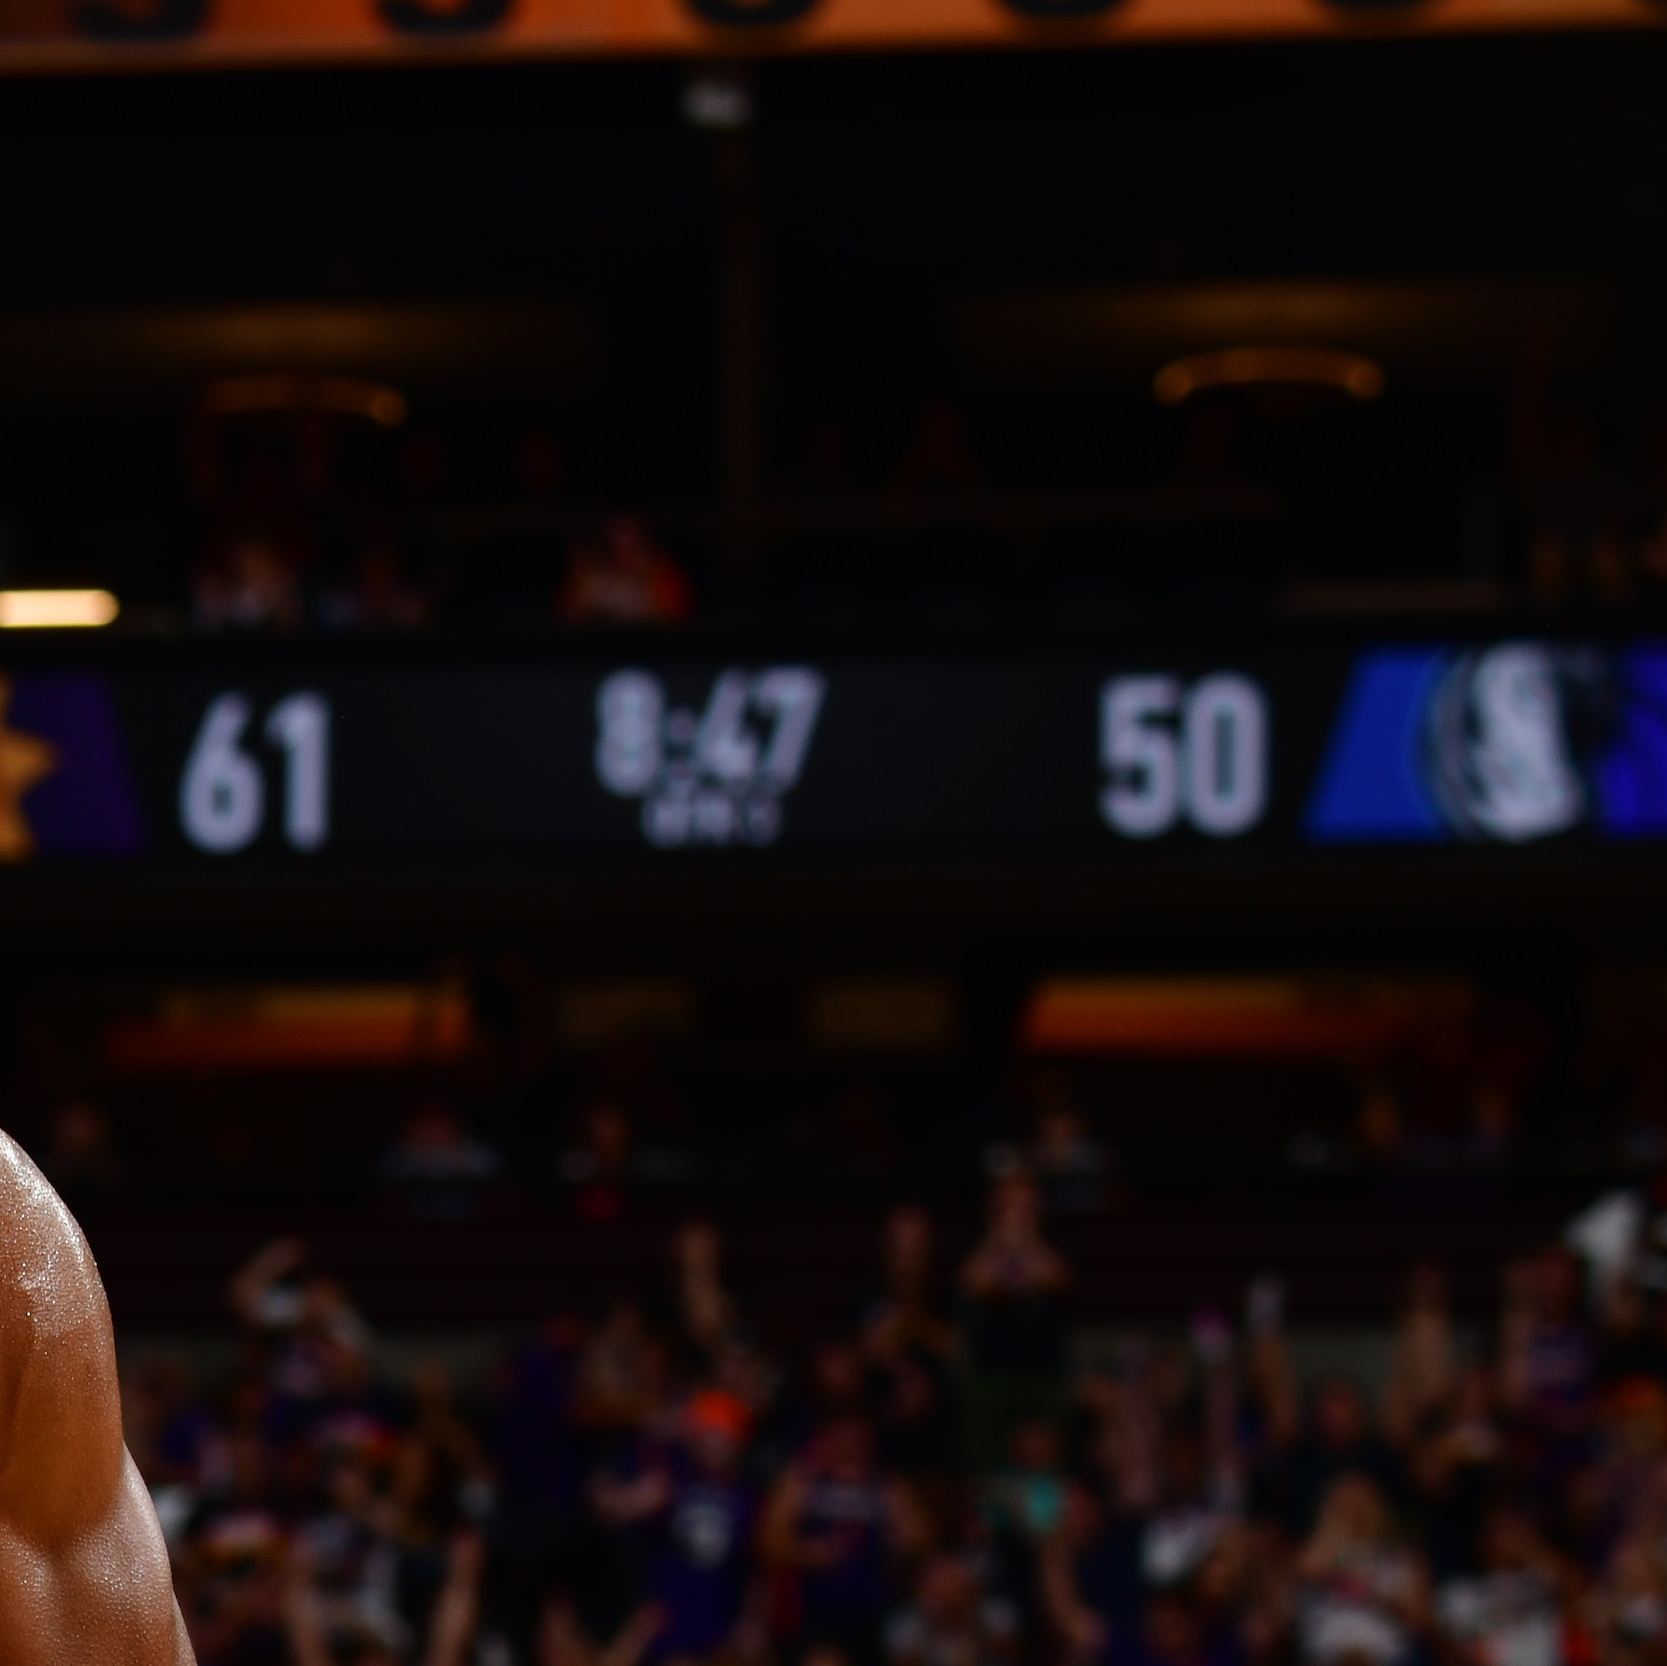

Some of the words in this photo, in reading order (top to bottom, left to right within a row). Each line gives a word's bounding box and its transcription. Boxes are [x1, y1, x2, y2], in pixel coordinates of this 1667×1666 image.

[178, 688, 333, 855] 61
[594, 664, 827, 799] 8:47
[1097, 668, 1271, 840] 50
